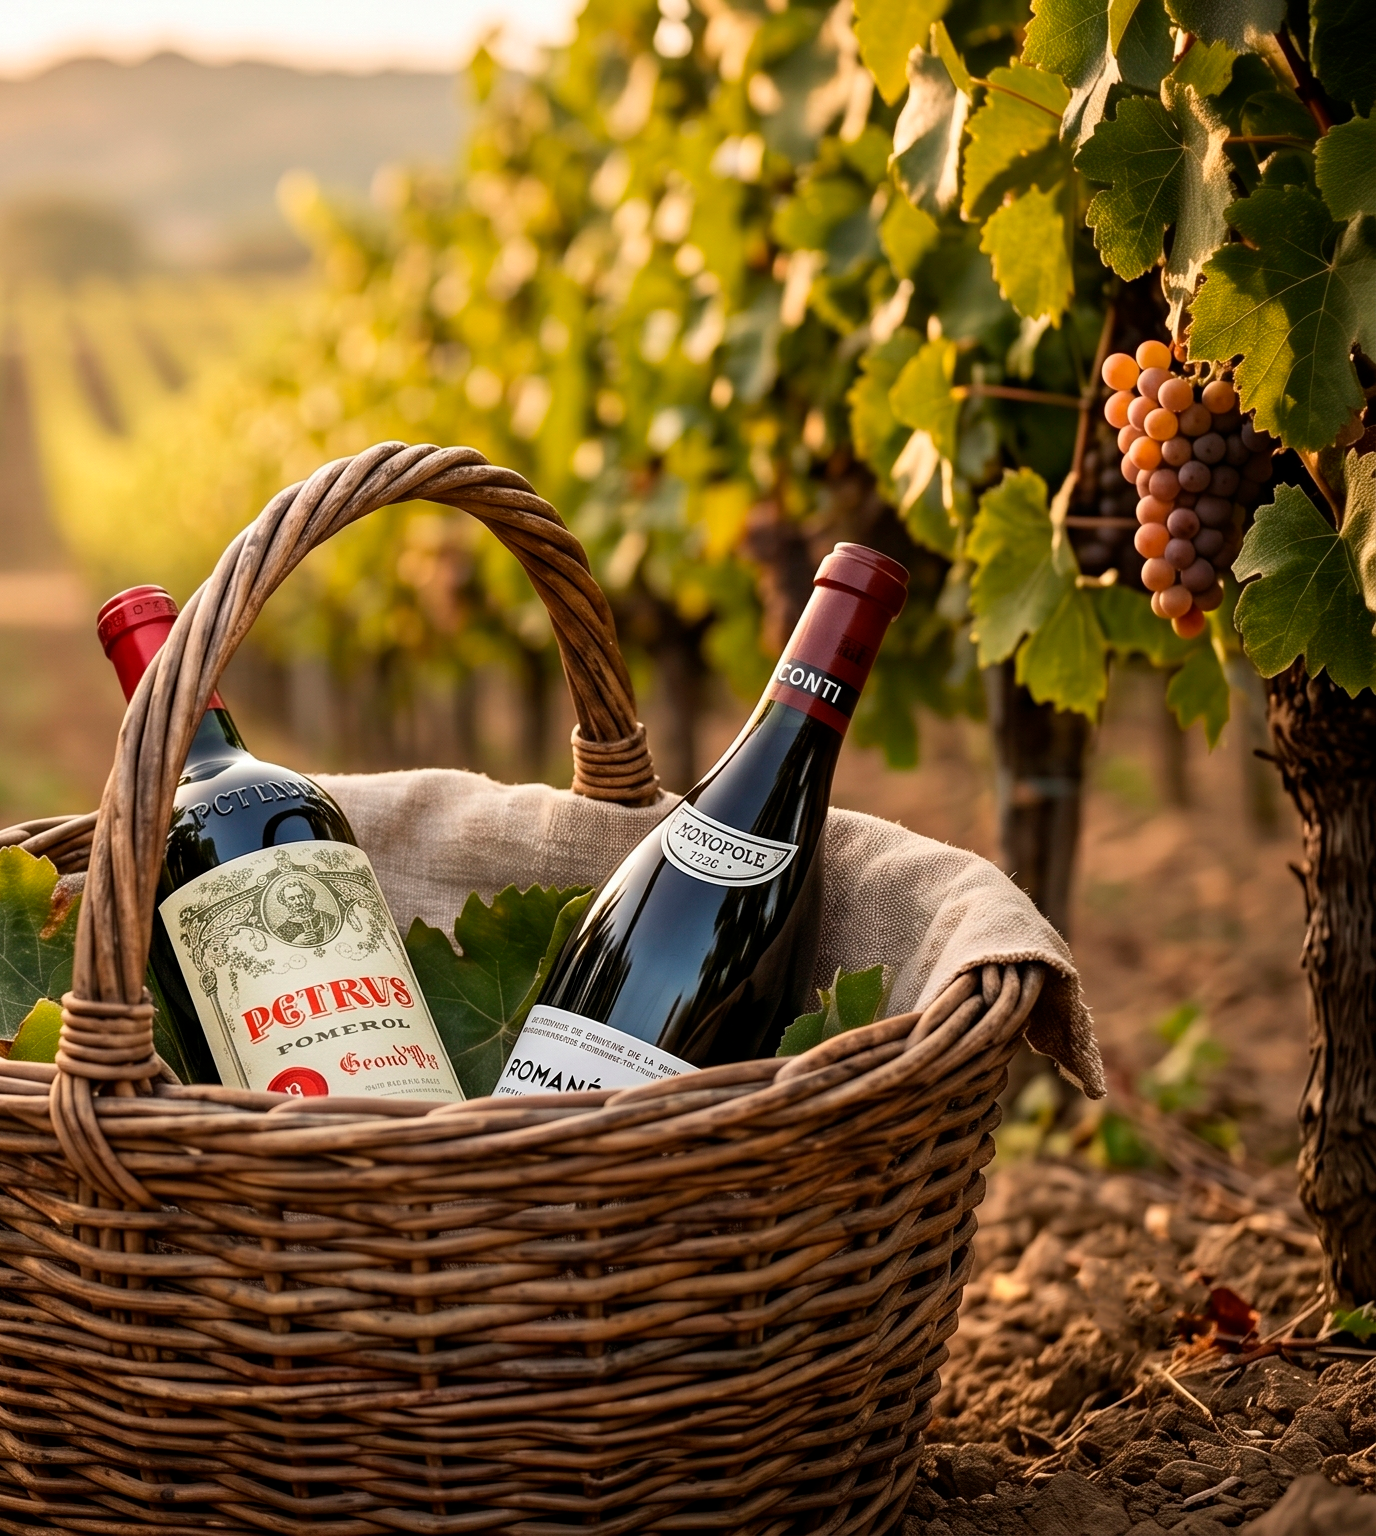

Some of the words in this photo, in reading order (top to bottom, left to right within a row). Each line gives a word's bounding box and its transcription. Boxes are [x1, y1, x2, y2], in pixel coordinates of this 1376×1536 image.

[778, 664, 842, 704] CONTI
[675, 823, 767, 869] MONOPOLE
[276, 1018, 410, 1056] POMEROL
